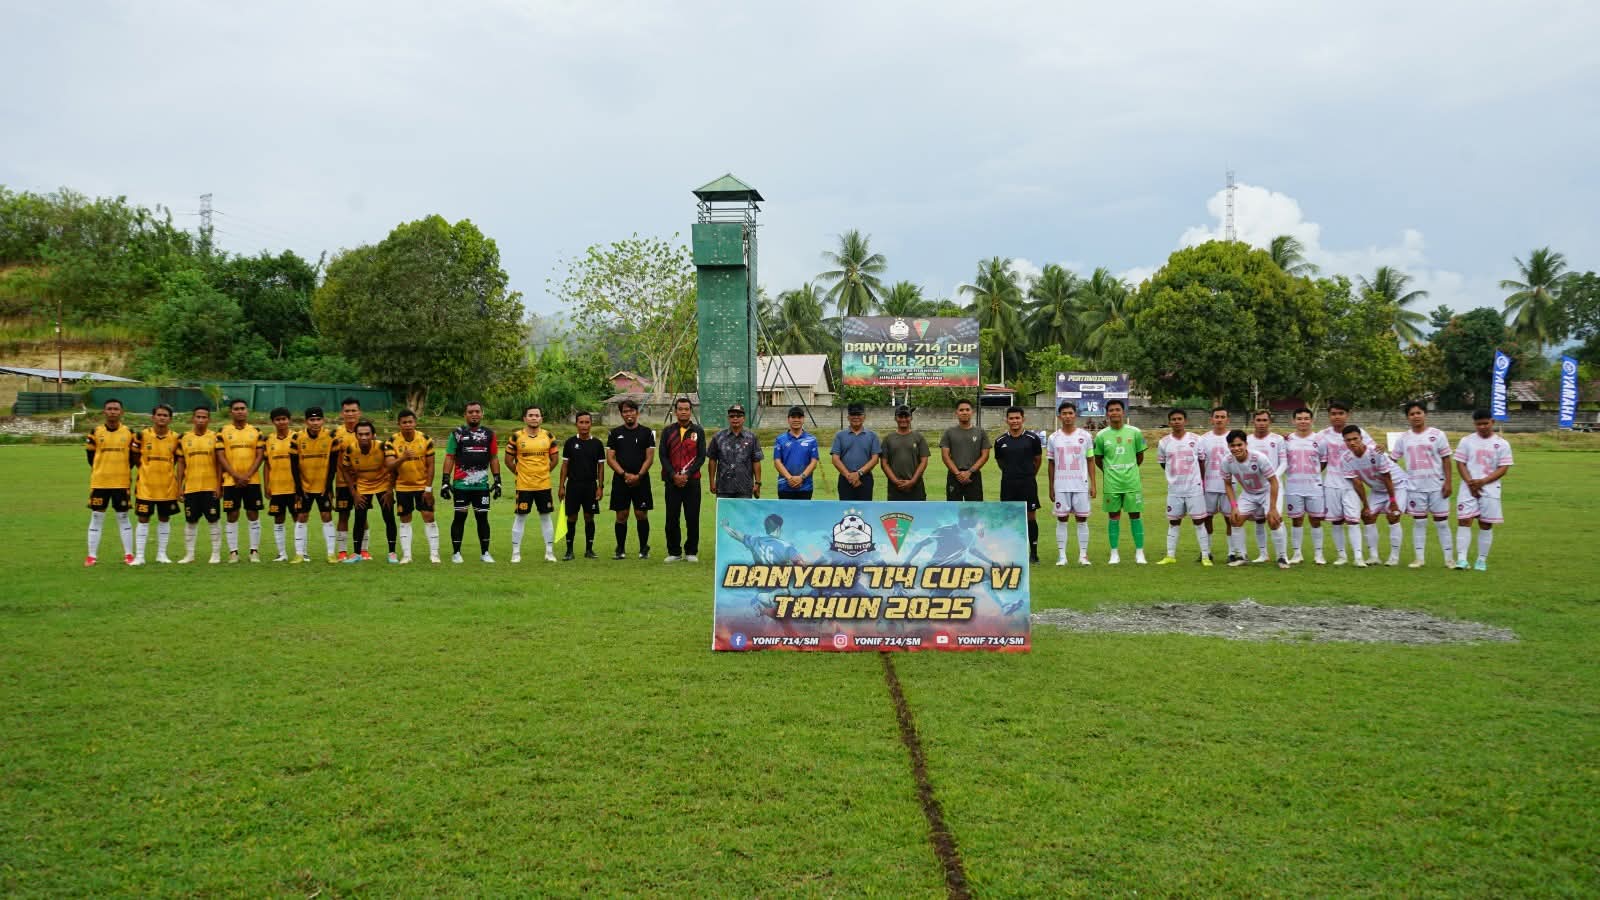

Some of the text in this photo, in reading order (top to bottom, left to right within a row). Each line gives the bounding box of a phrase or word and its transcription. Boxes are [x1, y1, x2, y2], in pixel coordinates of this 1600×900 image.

[844, 342, 977, 353] DANYON 714 CUP
[885, 355, 907, 366] TA
[914, 355, 960, 367] 2025
[1493, 370, 1506, 416] YAMAHA
[1561, 375, 1576, 421] YAMAHA
[1087, 401, 1098, 412] VS
[1056, 446, 1082, 471] 17
[723, 565, 1022, 589] DANYON 714 CUP VI
[775, 597, 974, 620] TAHUN 2025
[752, 637, 819, 646] YONIF 714/SM
[854, 637, 921, 646] YONIF 714/SM
[957, 636, 1024, 646] YONIF 714/SM
